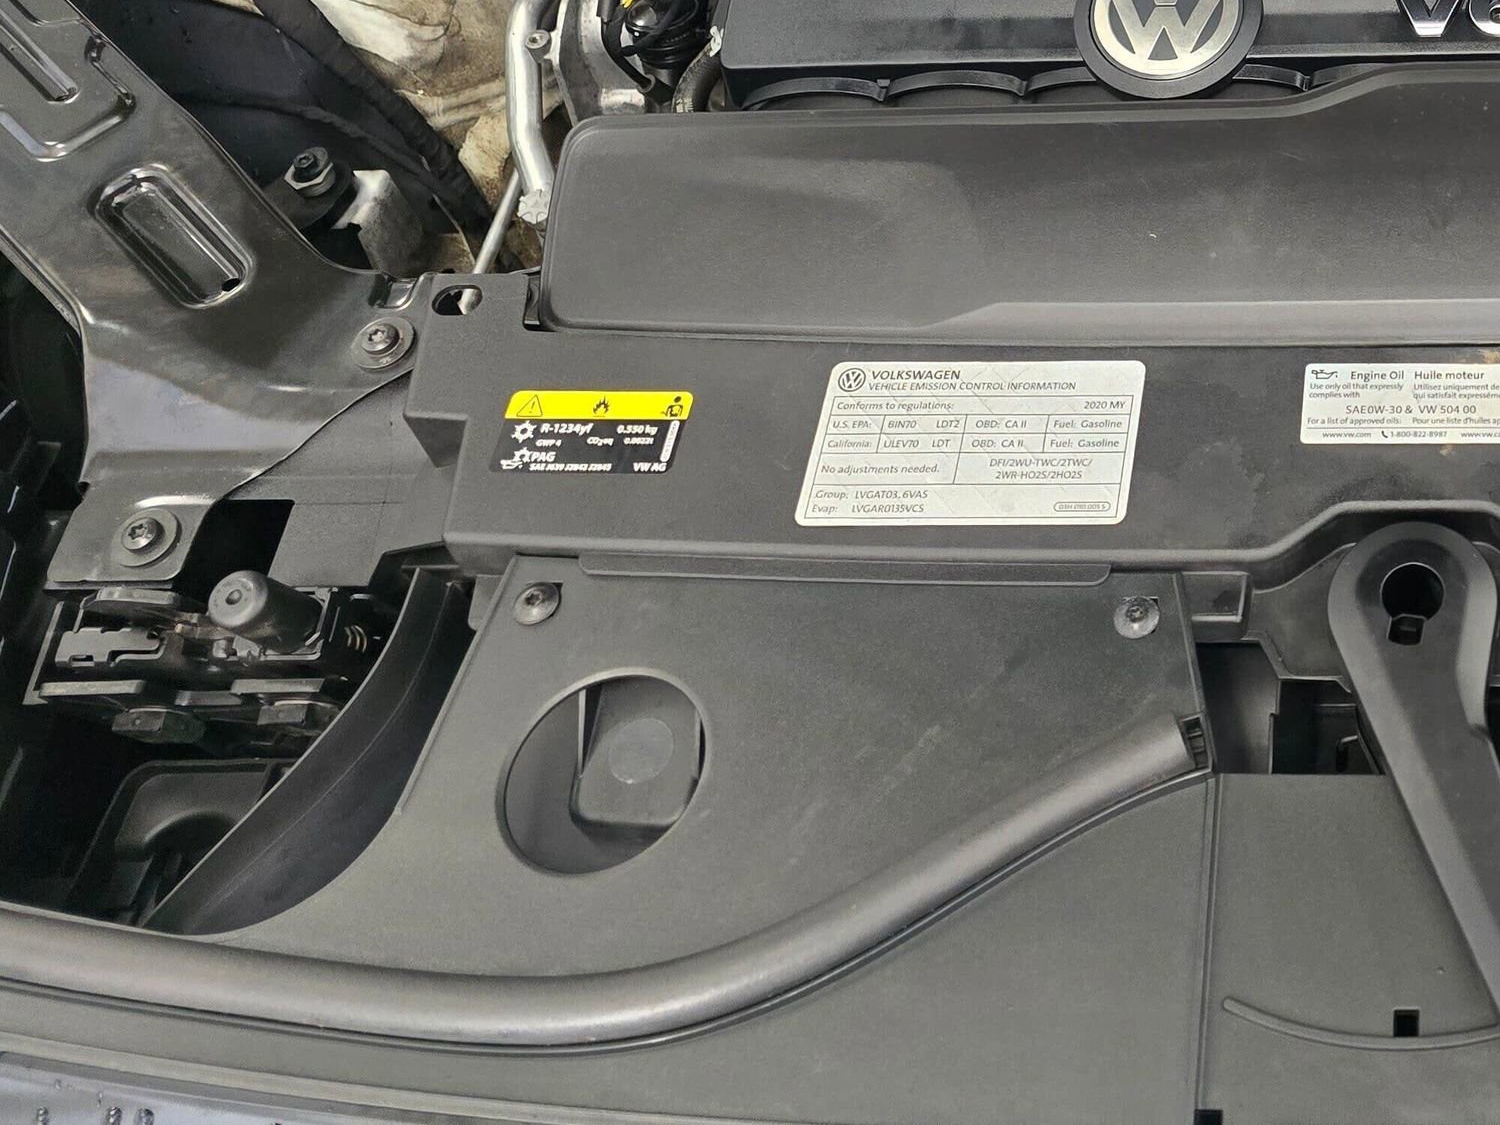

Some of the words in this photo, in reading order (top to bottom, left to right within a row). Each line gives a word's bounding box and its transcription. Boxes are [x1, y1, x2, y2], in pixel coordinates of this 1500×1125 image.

[872, 370, 960, 380] VOLKSWAGEN
[1351, 371, 1386, 382] Engine
[1390, 371, 1404, 380] Oil
[1414, 371, 1442, 380] Huile
[869, 382, 907, 390] VEHICLE
[910, 382, 956, 390] EMISSION
[960, 382, 1004, 390] CONTROL
[1008, 382, 1076, 390] INFORMATION
[1370, 383, 1403, 391] expressly
[1443, 384, 1488, 392] uniquement
[886, 402, 895, 410] to
[898, 402, 954, 412] regulations:
[1084, 401, 1108, 410] 2020
[1110, 401, 1126, 410] MY
[1346, 405, 1402, 414] SAE0W-30
[1404, 405, 1414, 414] &
[1418, 405, 1438, 414] VW
[1440, 405, 1460, 414] 504
[1463, 405, 1476, 414] 00
[832, 420, 849, 428] U.S.
[852, 420, 872, 428] EPA:
[888, 420, 916, 428] BIN70
[936, 420, 960, 428] LDT2
[976, 420, 1000, 428] OBD:
[1005, 420, 1020, 428] CA
[1054, 420, 1076, 428] Fuel:
[1081, 420, 1122, 428] Gasoline
[1350, 418, 1384, 426] approved
[540, 423, 594, 436] R-1234yf
[645, 424, 658, 436] kg
[828, 440, 872, 448] California:
[884, 440, 920, 448] ULEV70
[932, 440, 950, 448] LDT
[972, 440, 996, 448] OBD:
[1001, 440, 1016, 448] CA
[1050, 439, 1073, 448] Fuel:
[1078, 439, 1120, 448] Gasoline
[532, 452, 556, 462] PAG
[990, 458, 1092, 467] DFI/2WU-TWC/2TWC/
[633, 463, 650, 472] VW
[650, 463, 667, 472] AG
[821, 465, 836, 474] No
[838, 465, 898, 475] adjustments
[901, 464, 940, 473] needed.
[996, 471, 1082, 479] 2WR-HO2S/2HO2S
[816, 490, 848, 500] Group:
[812, 504, 838, 514] Evap:
